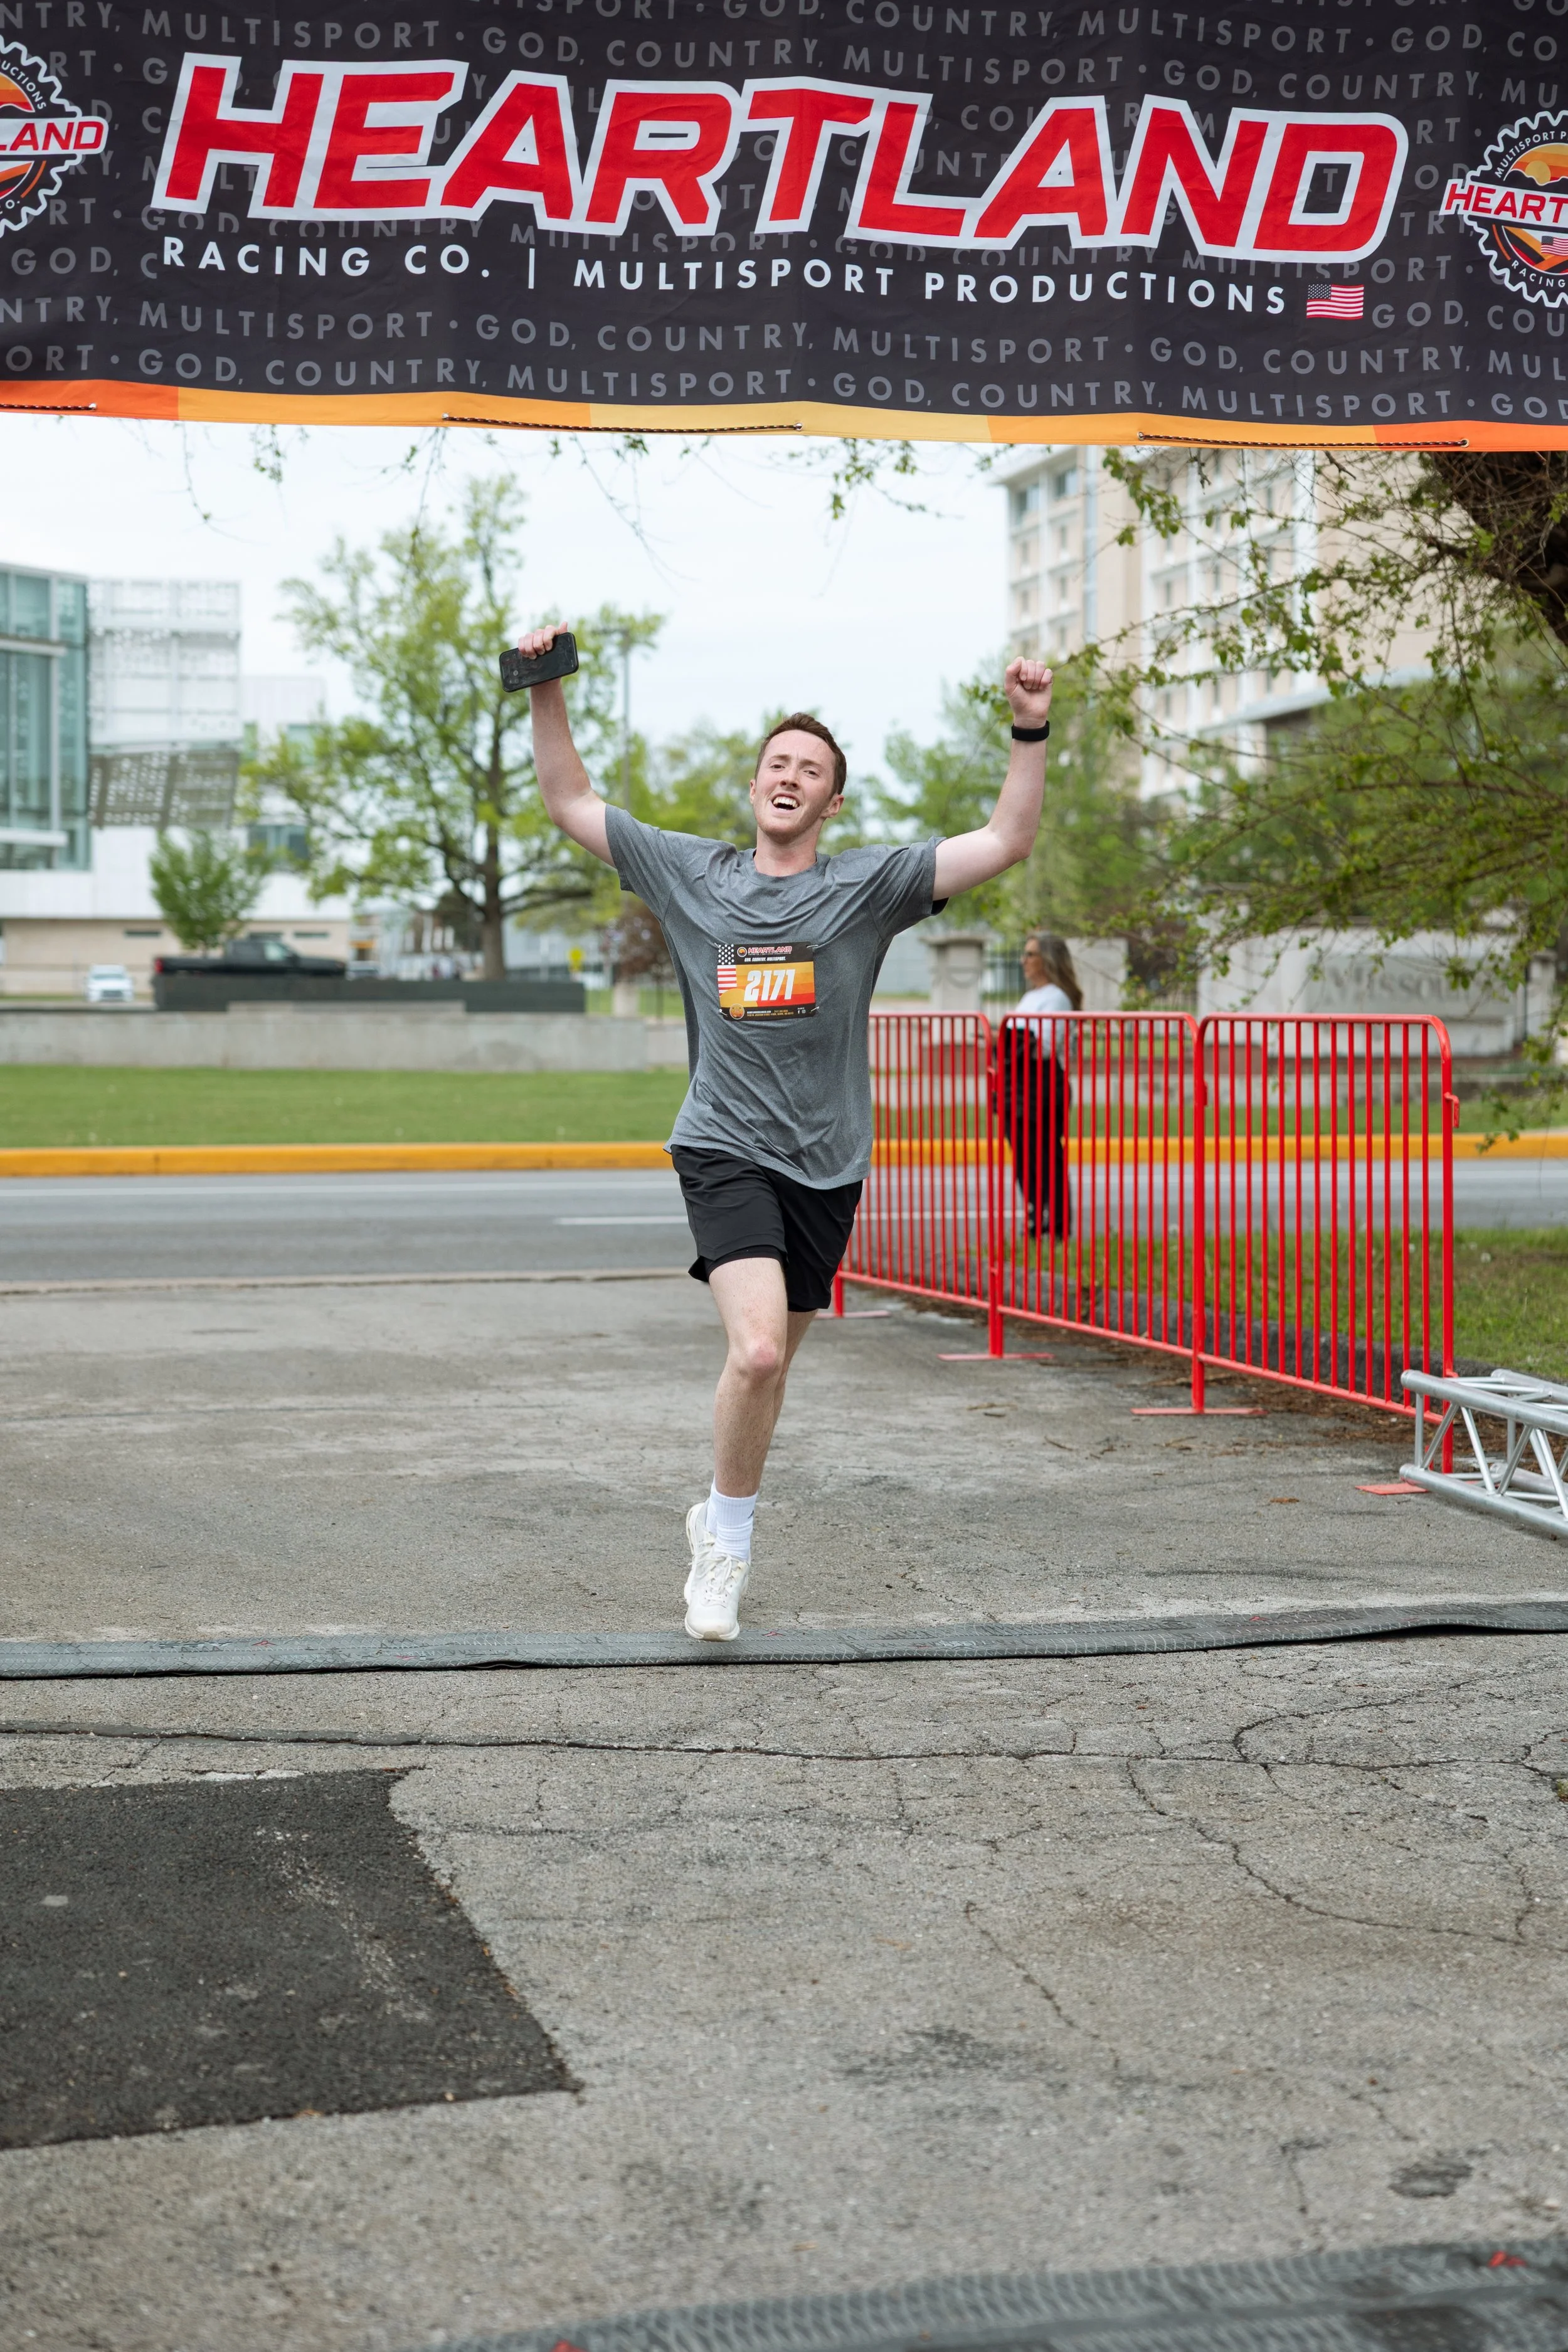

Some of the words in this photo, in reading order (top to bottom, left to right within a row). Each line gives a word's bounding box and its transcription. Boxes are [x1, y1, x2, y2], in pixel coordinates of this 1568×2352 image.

[142, 9, 439, 49] MULTISPORT
[483, 27, 584, 65] GOD,
[607, 38, 823, 68] COUNTRY,
[844, 45, 1123, 84] MULTISPORT
[1164, 60, 1257, 98] GOD,
[1279, 70, 1483, 100] COUNTRY,
[1078, 8, 1351, 53] MULTISPORT
[1391, 24, 1486, 53] GOD,
[151, 52, 1409, 263] HEARTLAND
[1495, 131, 1555, 179] MULTISPORT
[11, 246, 118, 276] GOD,
[163, 236, 370, 277] RACING
[404, 244, 490, 278] CO.
[573, 258, 894, 296] MULTISPORT
[924, 271, 1285, 315] PRODUCTIONS
[1512, 259, 1565, 288] RACING
[139, 301, 432, 340] MULTISPORT
[476, 314, 576, 350] GOD,
[598, 322, 813, 352] COUNTRY,
[833, 327, 1108, 364] MULTISPORT
[1150, 337, 1243, 373] GOD,
[1263, 346, 1470, 374] COUNTRY,
[1372, 300, 1468, 328] GOD,
[139, 349, 243, 384] GOD,
[265, 358, 487, 387] COUNTRY,
[507, 364, 792, 397] MULTISPORT
[834, 373, 931, 406] GOD,
[951, 381, 1162, 408] COUNTRY,
[1182, 386, 1451, 418] MULTISPORT
[744, 969, 795, 1002] 2171
